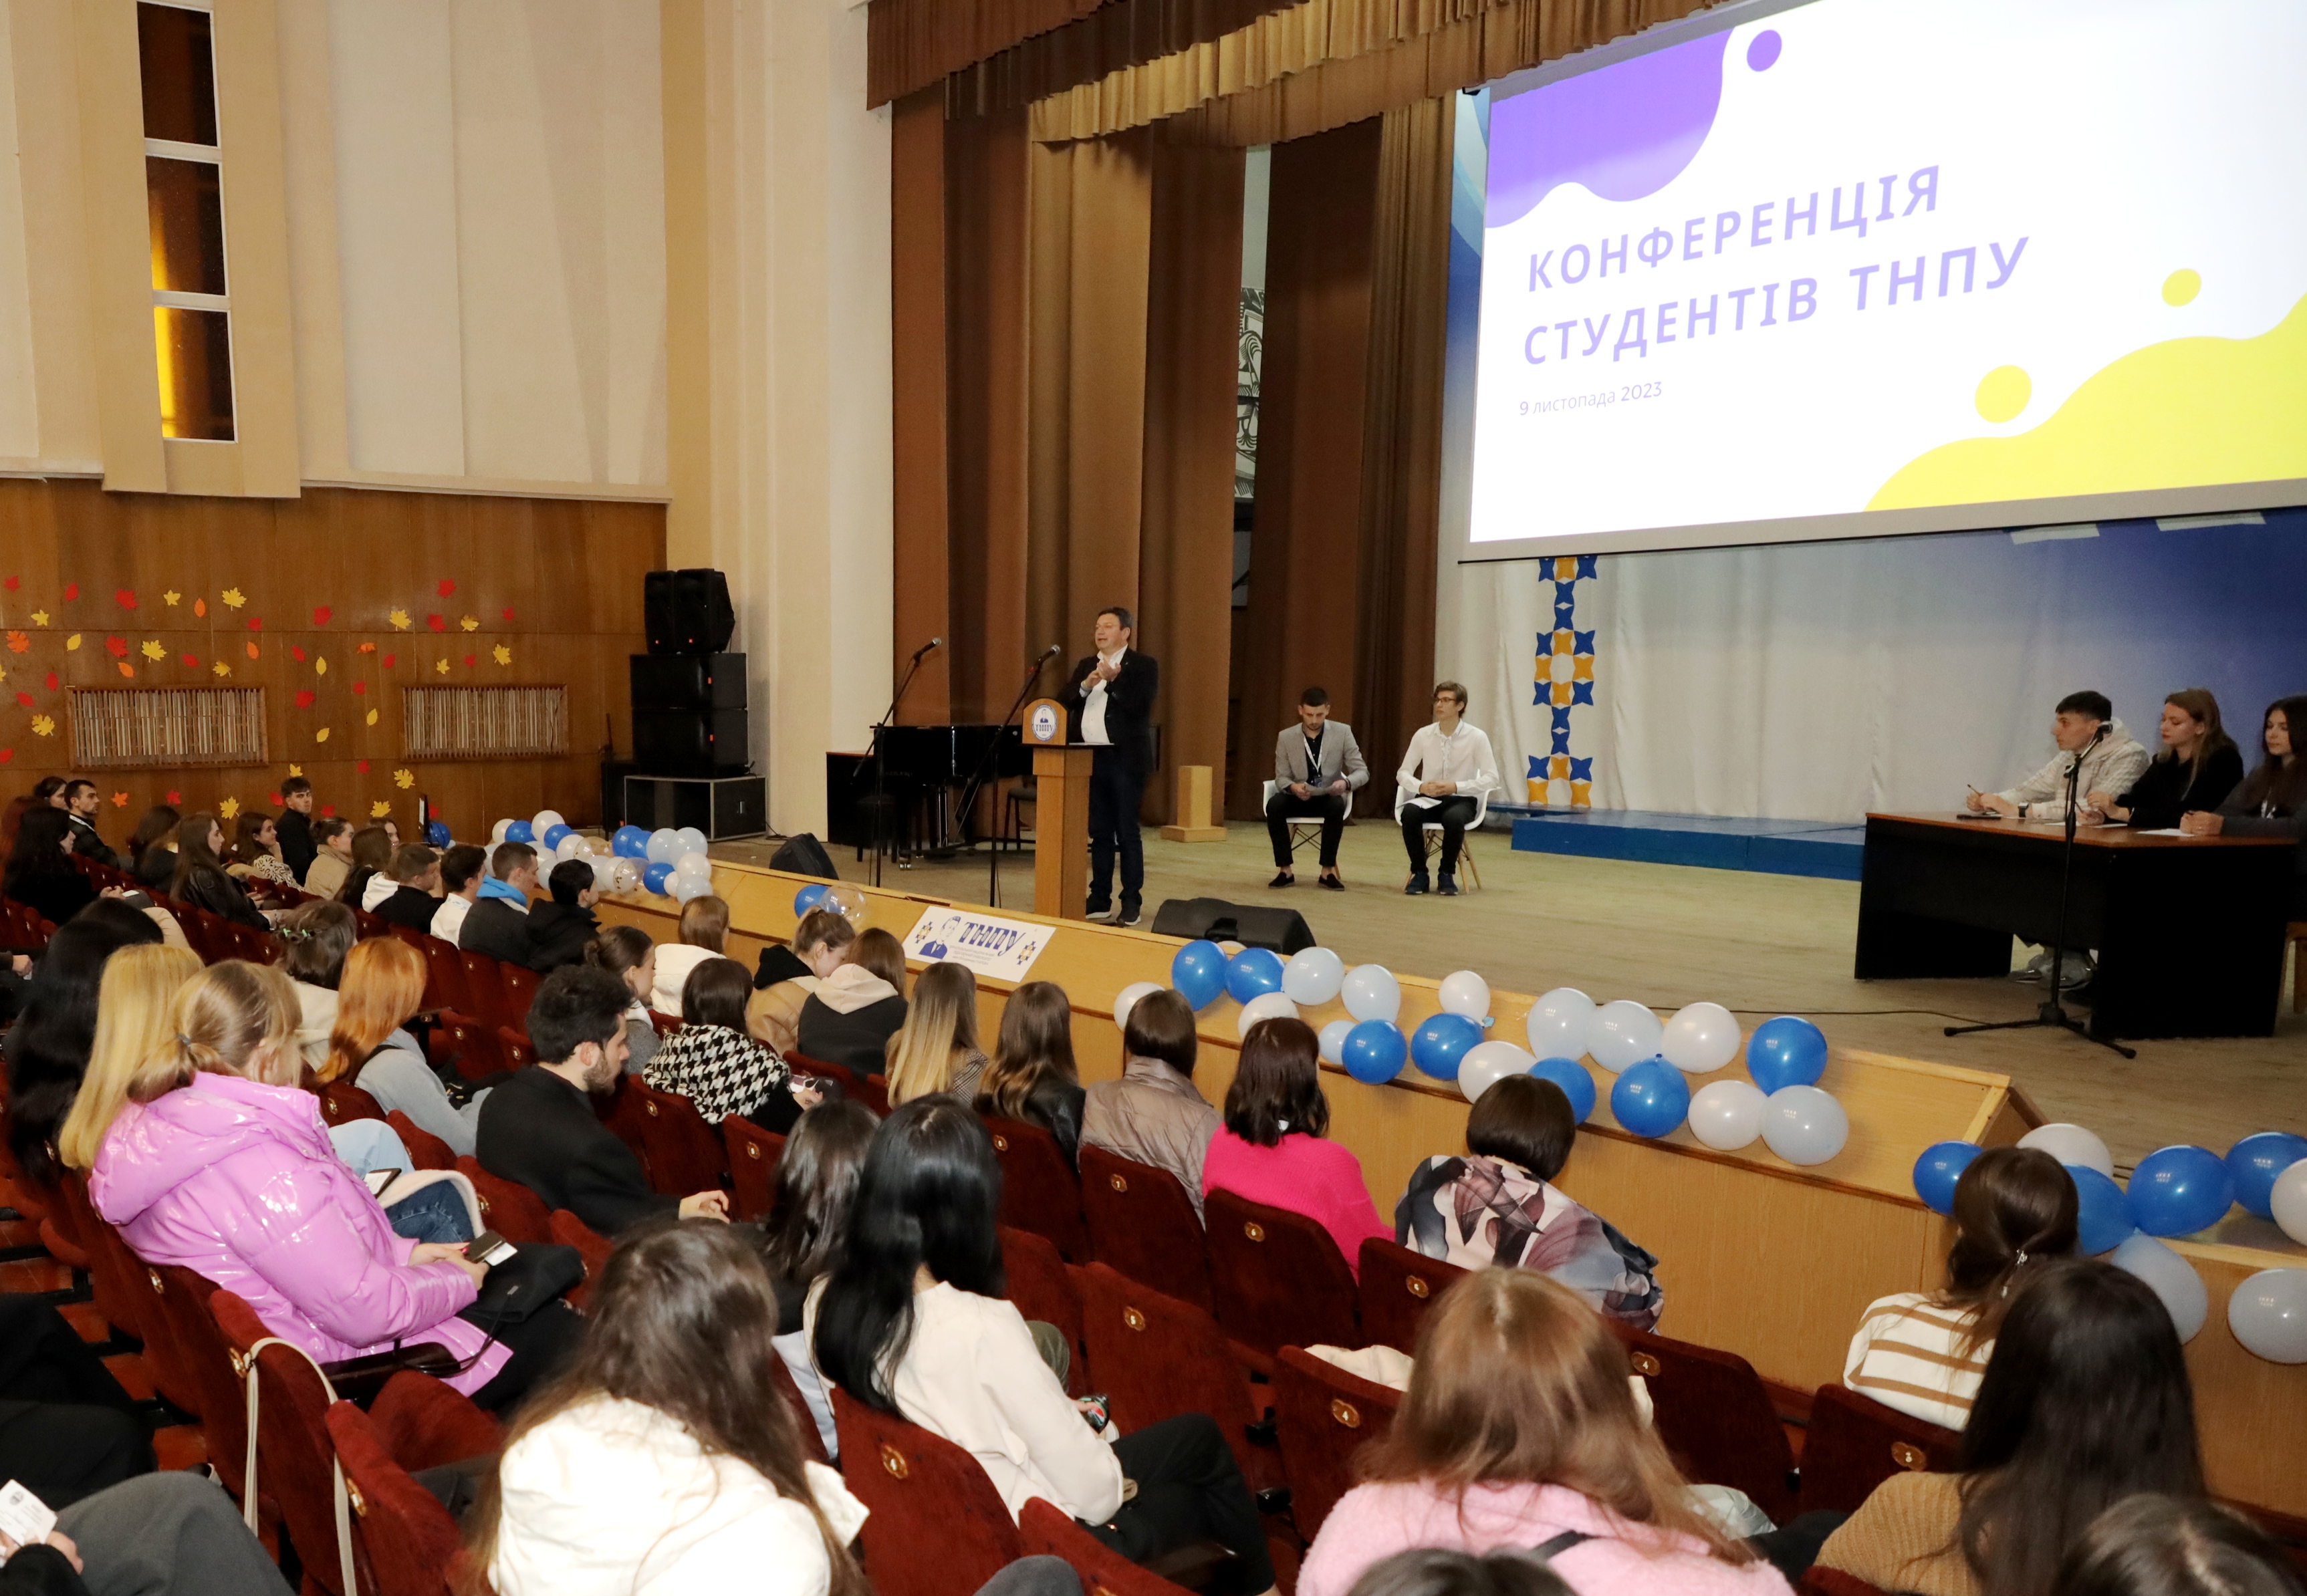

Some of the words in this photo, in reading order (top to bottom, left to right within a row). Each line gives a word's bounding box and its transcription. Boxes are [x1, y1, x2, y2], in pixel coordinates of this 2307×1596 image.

[1528, 164, 1940, 293] КОНФЕРЕНЦІЯ
[1524, 277, 1819, 365] СТУДЕНТІВ
[1848, 236, 2030, 311] ТНПУ
[1520, 401, 1529, 416] 9
[1532, 391, 1616, 414] листопада
[1620, 381, 1663, 402] 2023
[959, 922, 1026, 956] ТНПУ
[1643, 1361, 1649, 1369] 4
